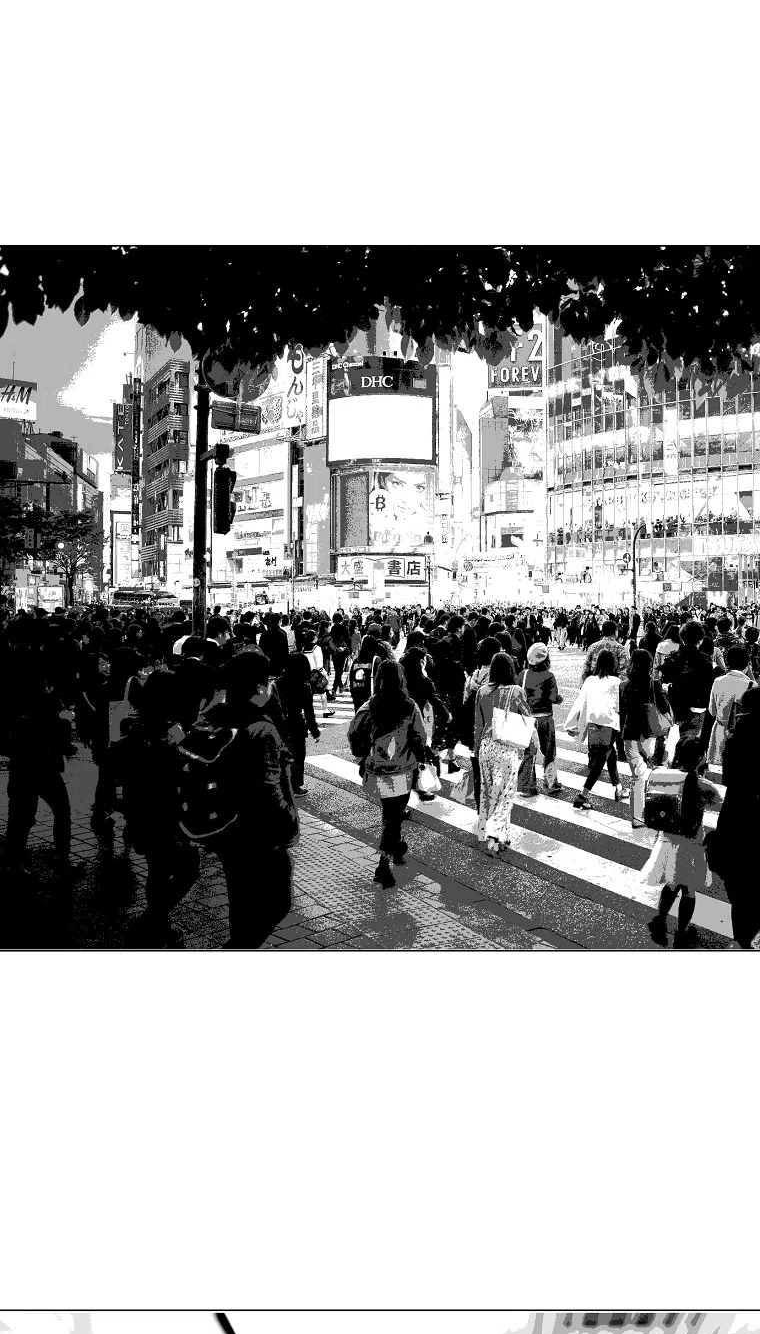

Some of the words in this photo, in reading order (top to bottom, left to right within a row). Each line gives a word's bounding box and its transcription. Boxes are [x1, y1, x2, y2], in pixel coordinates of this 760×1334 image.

[361, 375, 394, 388] DHC
[490, 366, 540, 383] FOREV
[0, 384, 33, 405] H&M
